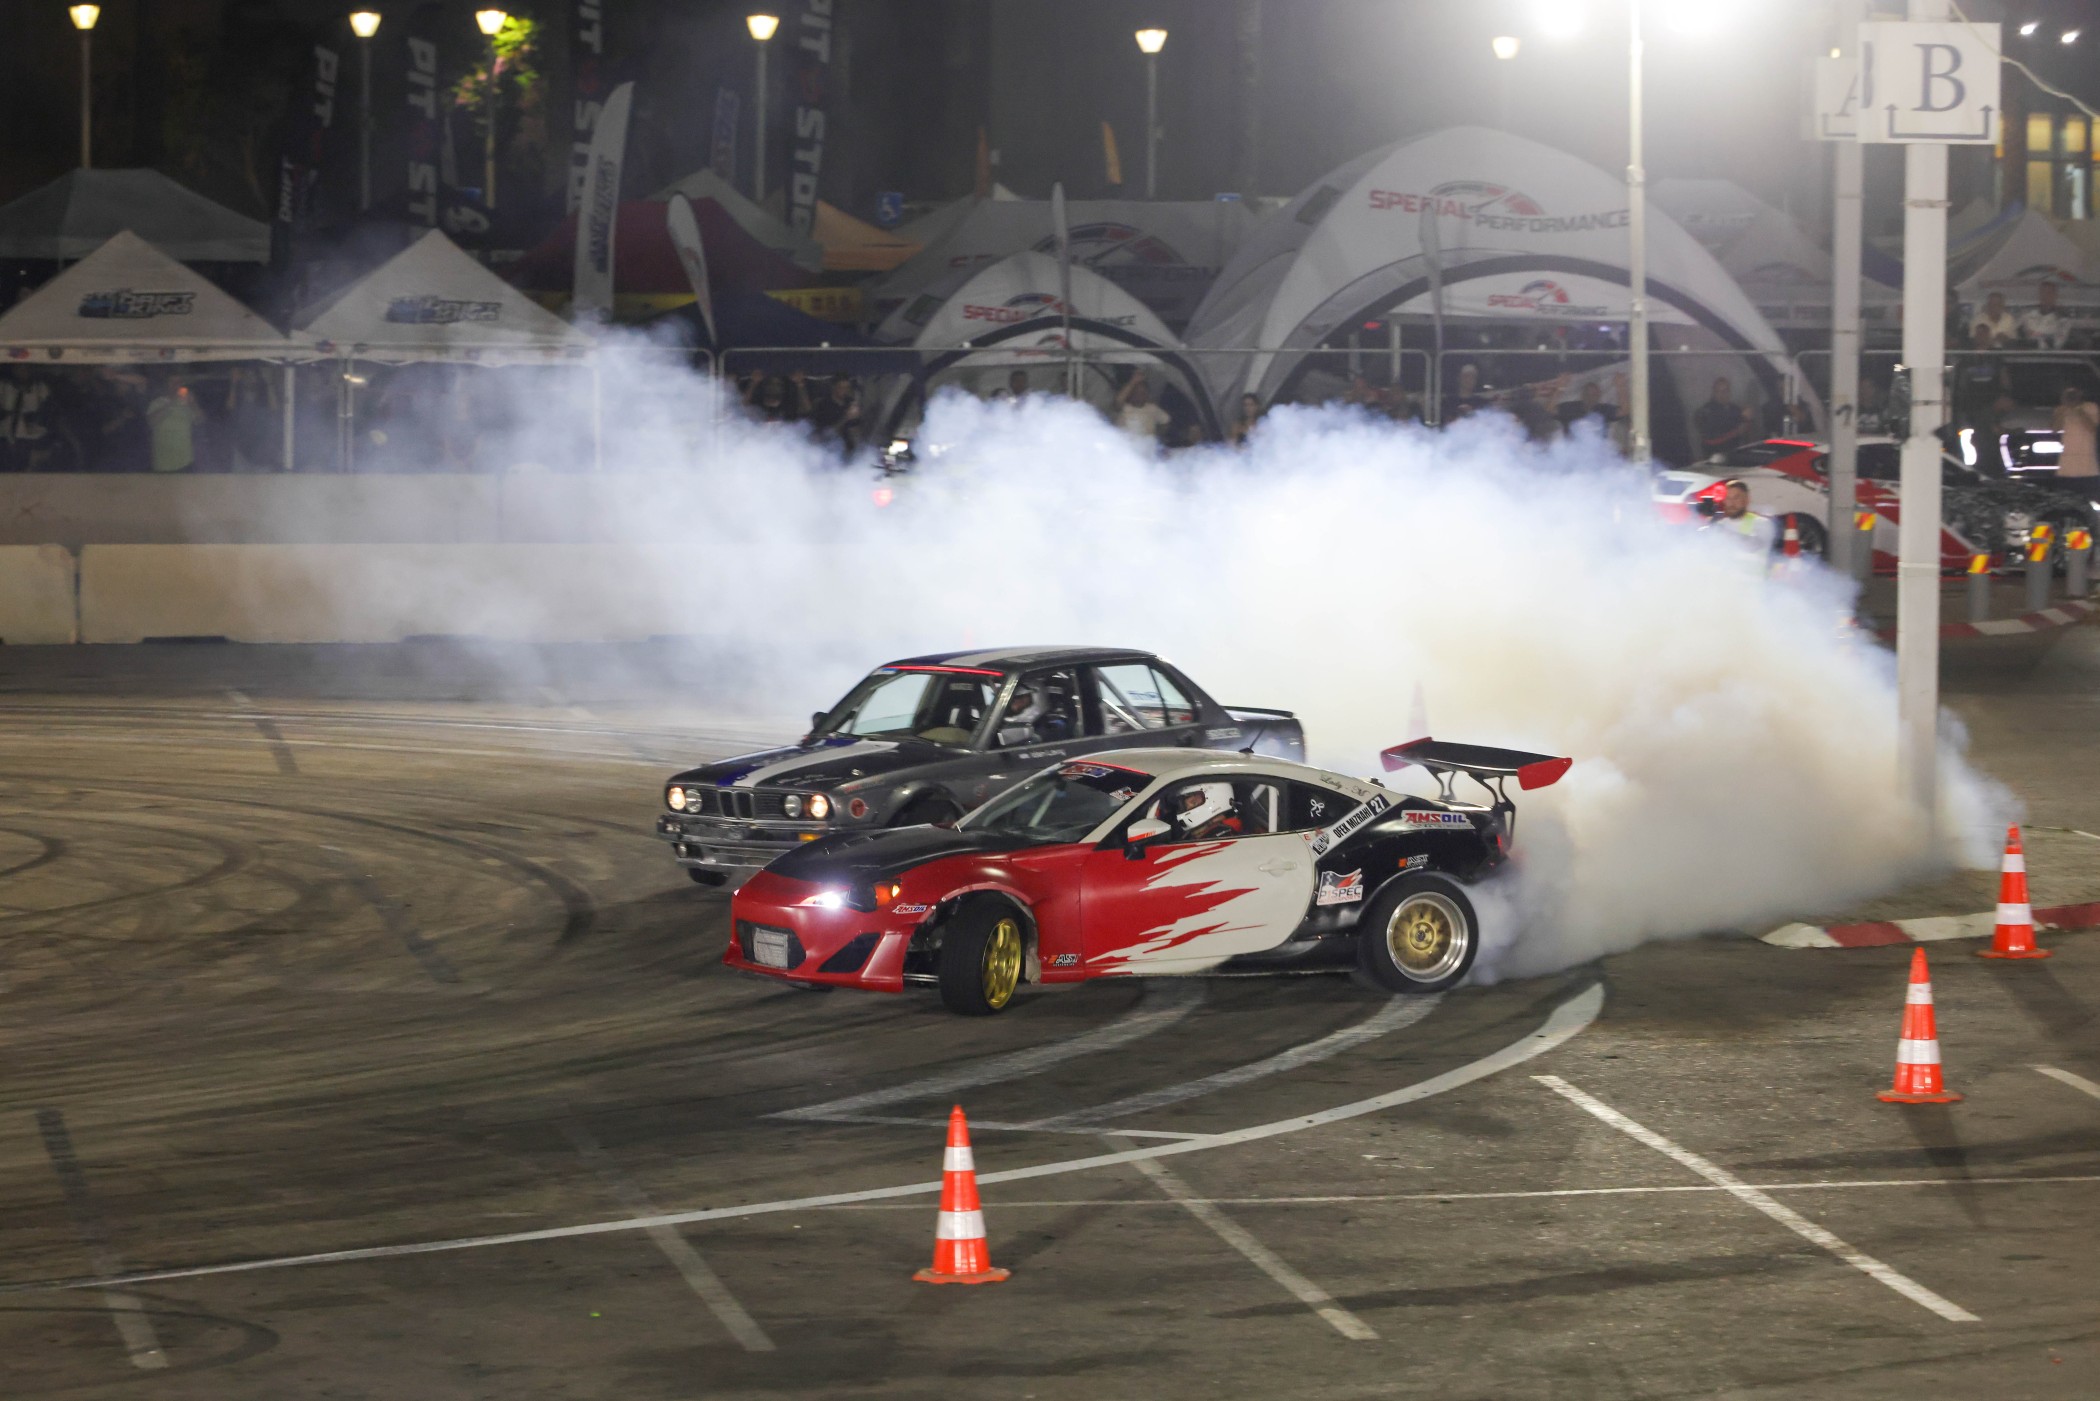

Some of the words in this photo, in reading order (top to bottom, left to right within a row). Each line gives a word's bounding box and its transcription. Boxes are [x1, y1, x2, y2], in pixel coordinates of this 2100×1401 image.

[578, 0, 602, 53] IT
[407, 36, 437, 120] PIT
[1911, 43, 1966, 113] B
[1474, 208, 1630, 233] PERFORMANCE
[1332, 822, 1351, 839] OFEK
[1345, 806, 1373, 829] MIZRAHI
[1370, 796, 1386, 814] 27
[1404, 812, 1467, 824] AMSOIL
